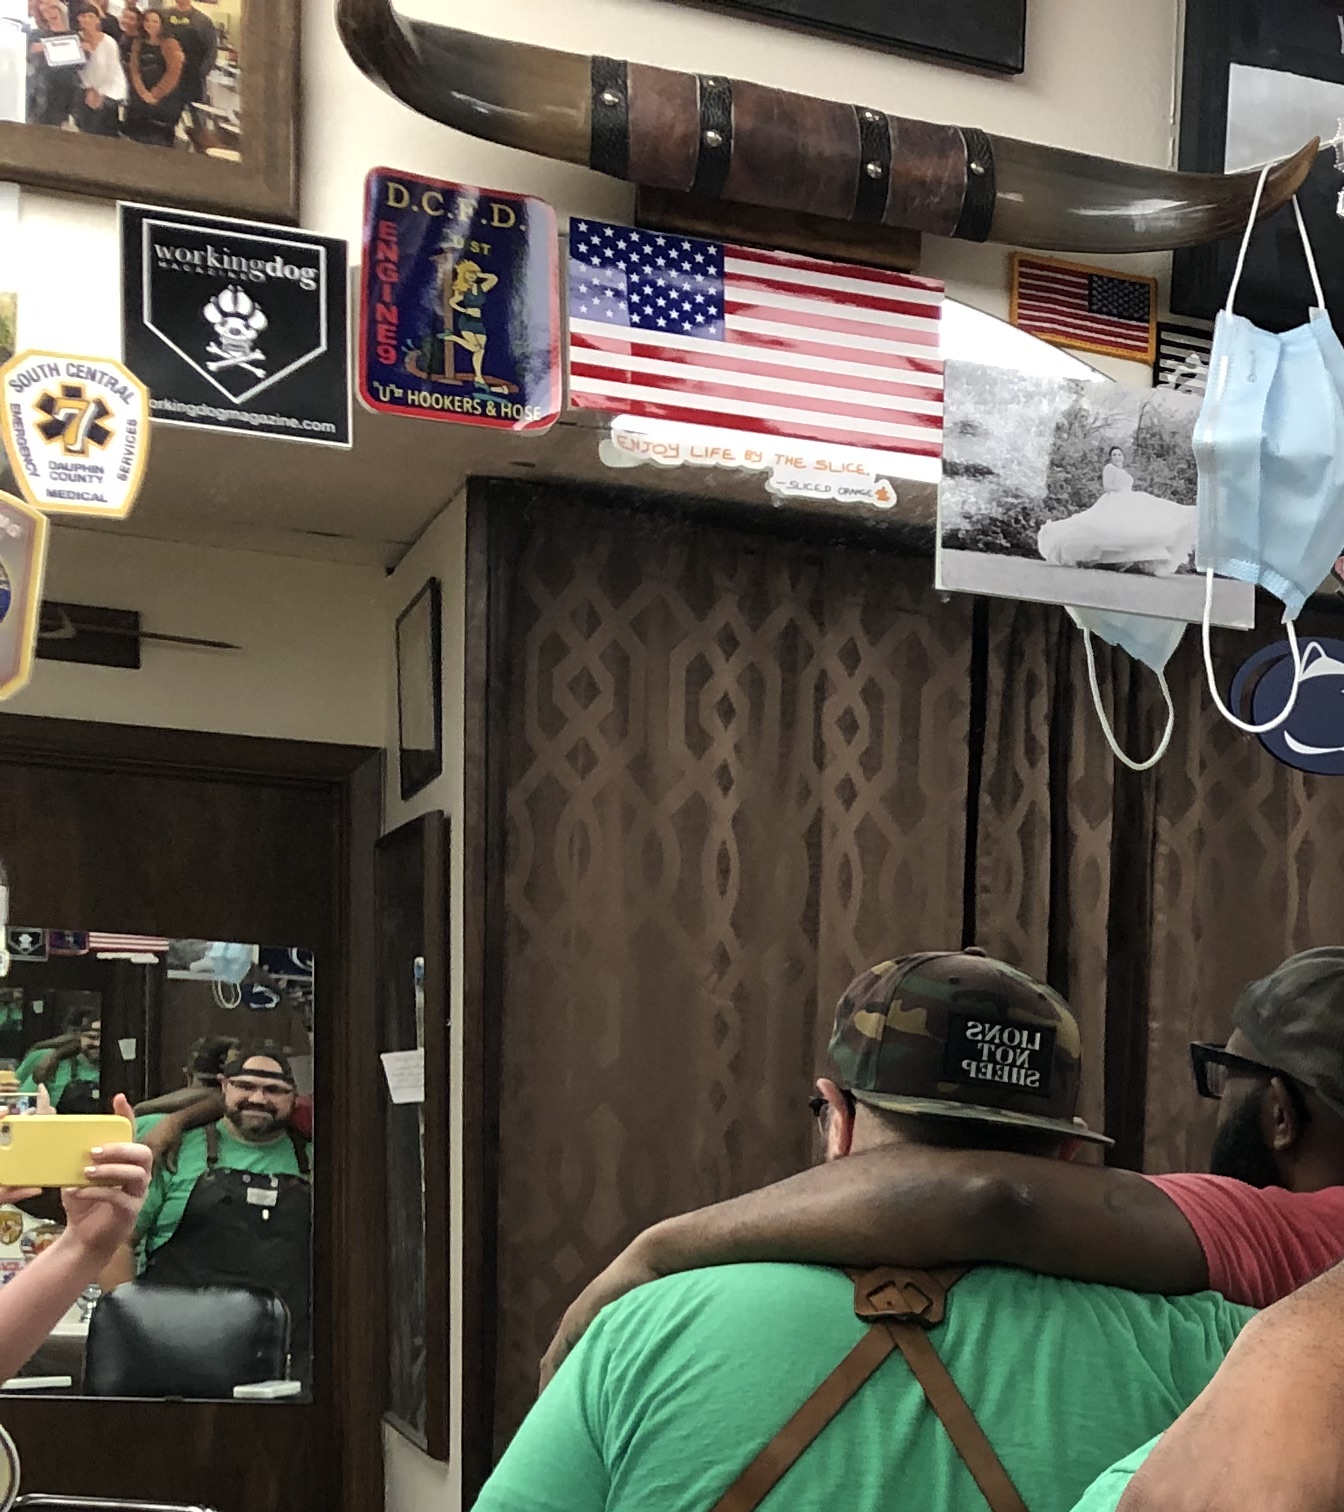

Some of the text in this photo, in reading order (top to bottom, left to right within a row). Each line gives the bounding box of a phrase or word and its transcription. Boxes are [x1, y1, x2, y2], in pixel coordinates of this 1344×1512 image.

[155, 244, 318, 290] workingdog
[8, 362, 135, 405] SOUTH CENTRAL
[149, 398, 336, 433] orkingdogmagazine.com
[407, 391, 482, 415] HOOKERS
[486, 402, 497, 417] &
[501, 402, 542, 421] HOSE
[10, 403, 41, 477] EMERGENCY
[616, 435, 681, 459] ENJOY
[689, 445, 736, 461] LIFE
[744, 448, 763, 463] BY
[774, 453, 807, 469] THE
[48, 460, 105, 474] DAUPHIN
[49, 471, 103, 483] COUNTY
[46, 488, 108, 503] MEDICAL
